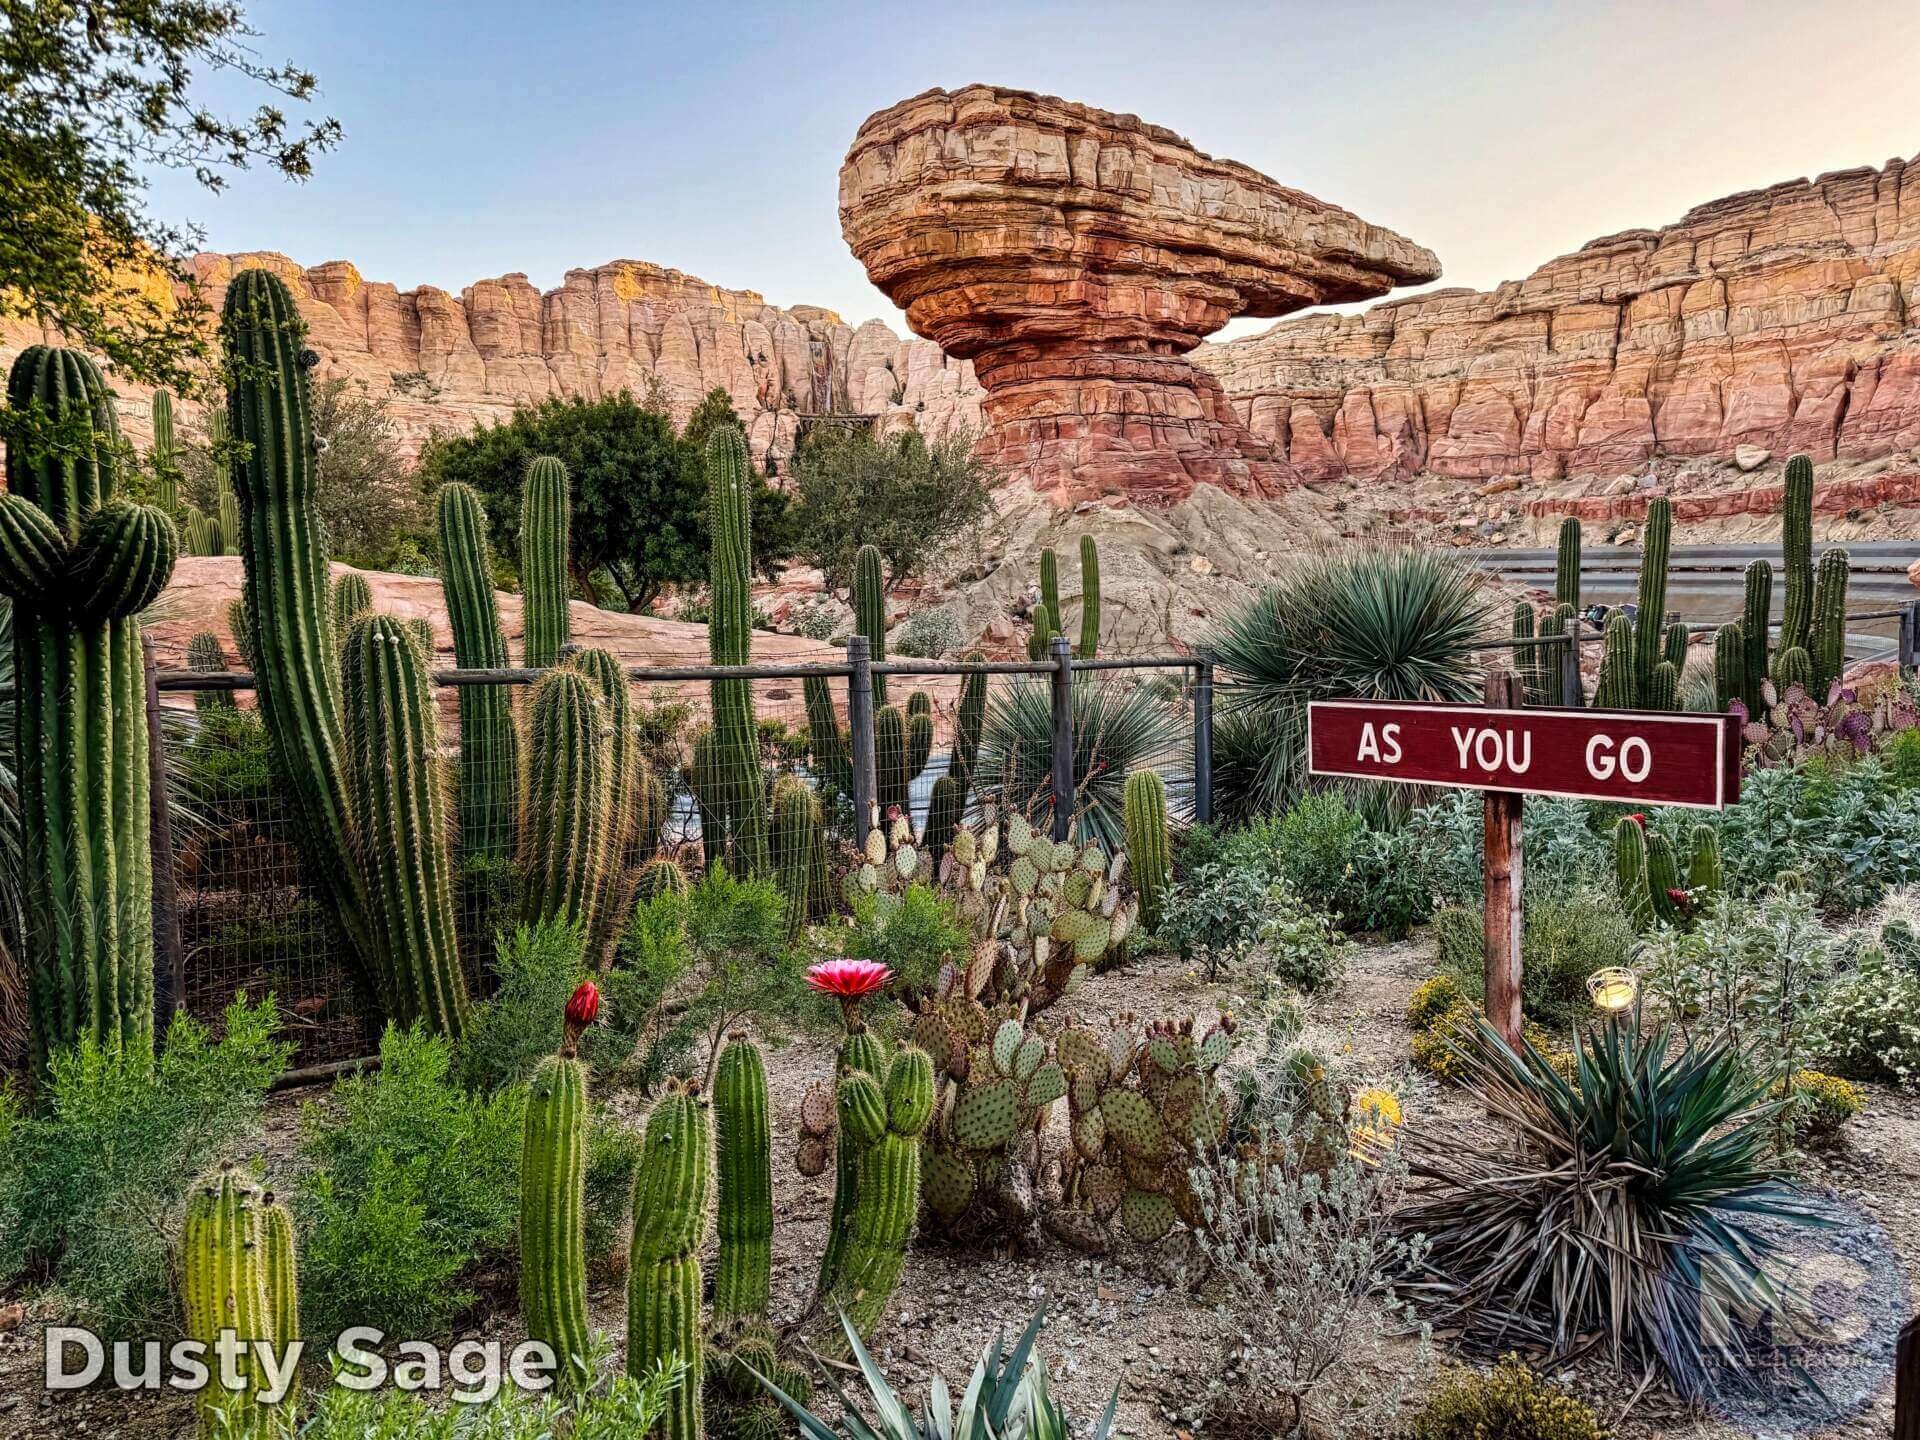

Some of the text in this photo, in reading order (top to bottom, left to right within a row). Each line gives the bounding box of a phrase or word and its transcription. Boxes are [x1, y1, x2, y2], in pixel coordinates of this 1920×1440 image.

[1357, 722, 1653, 783] AS YOU GO
